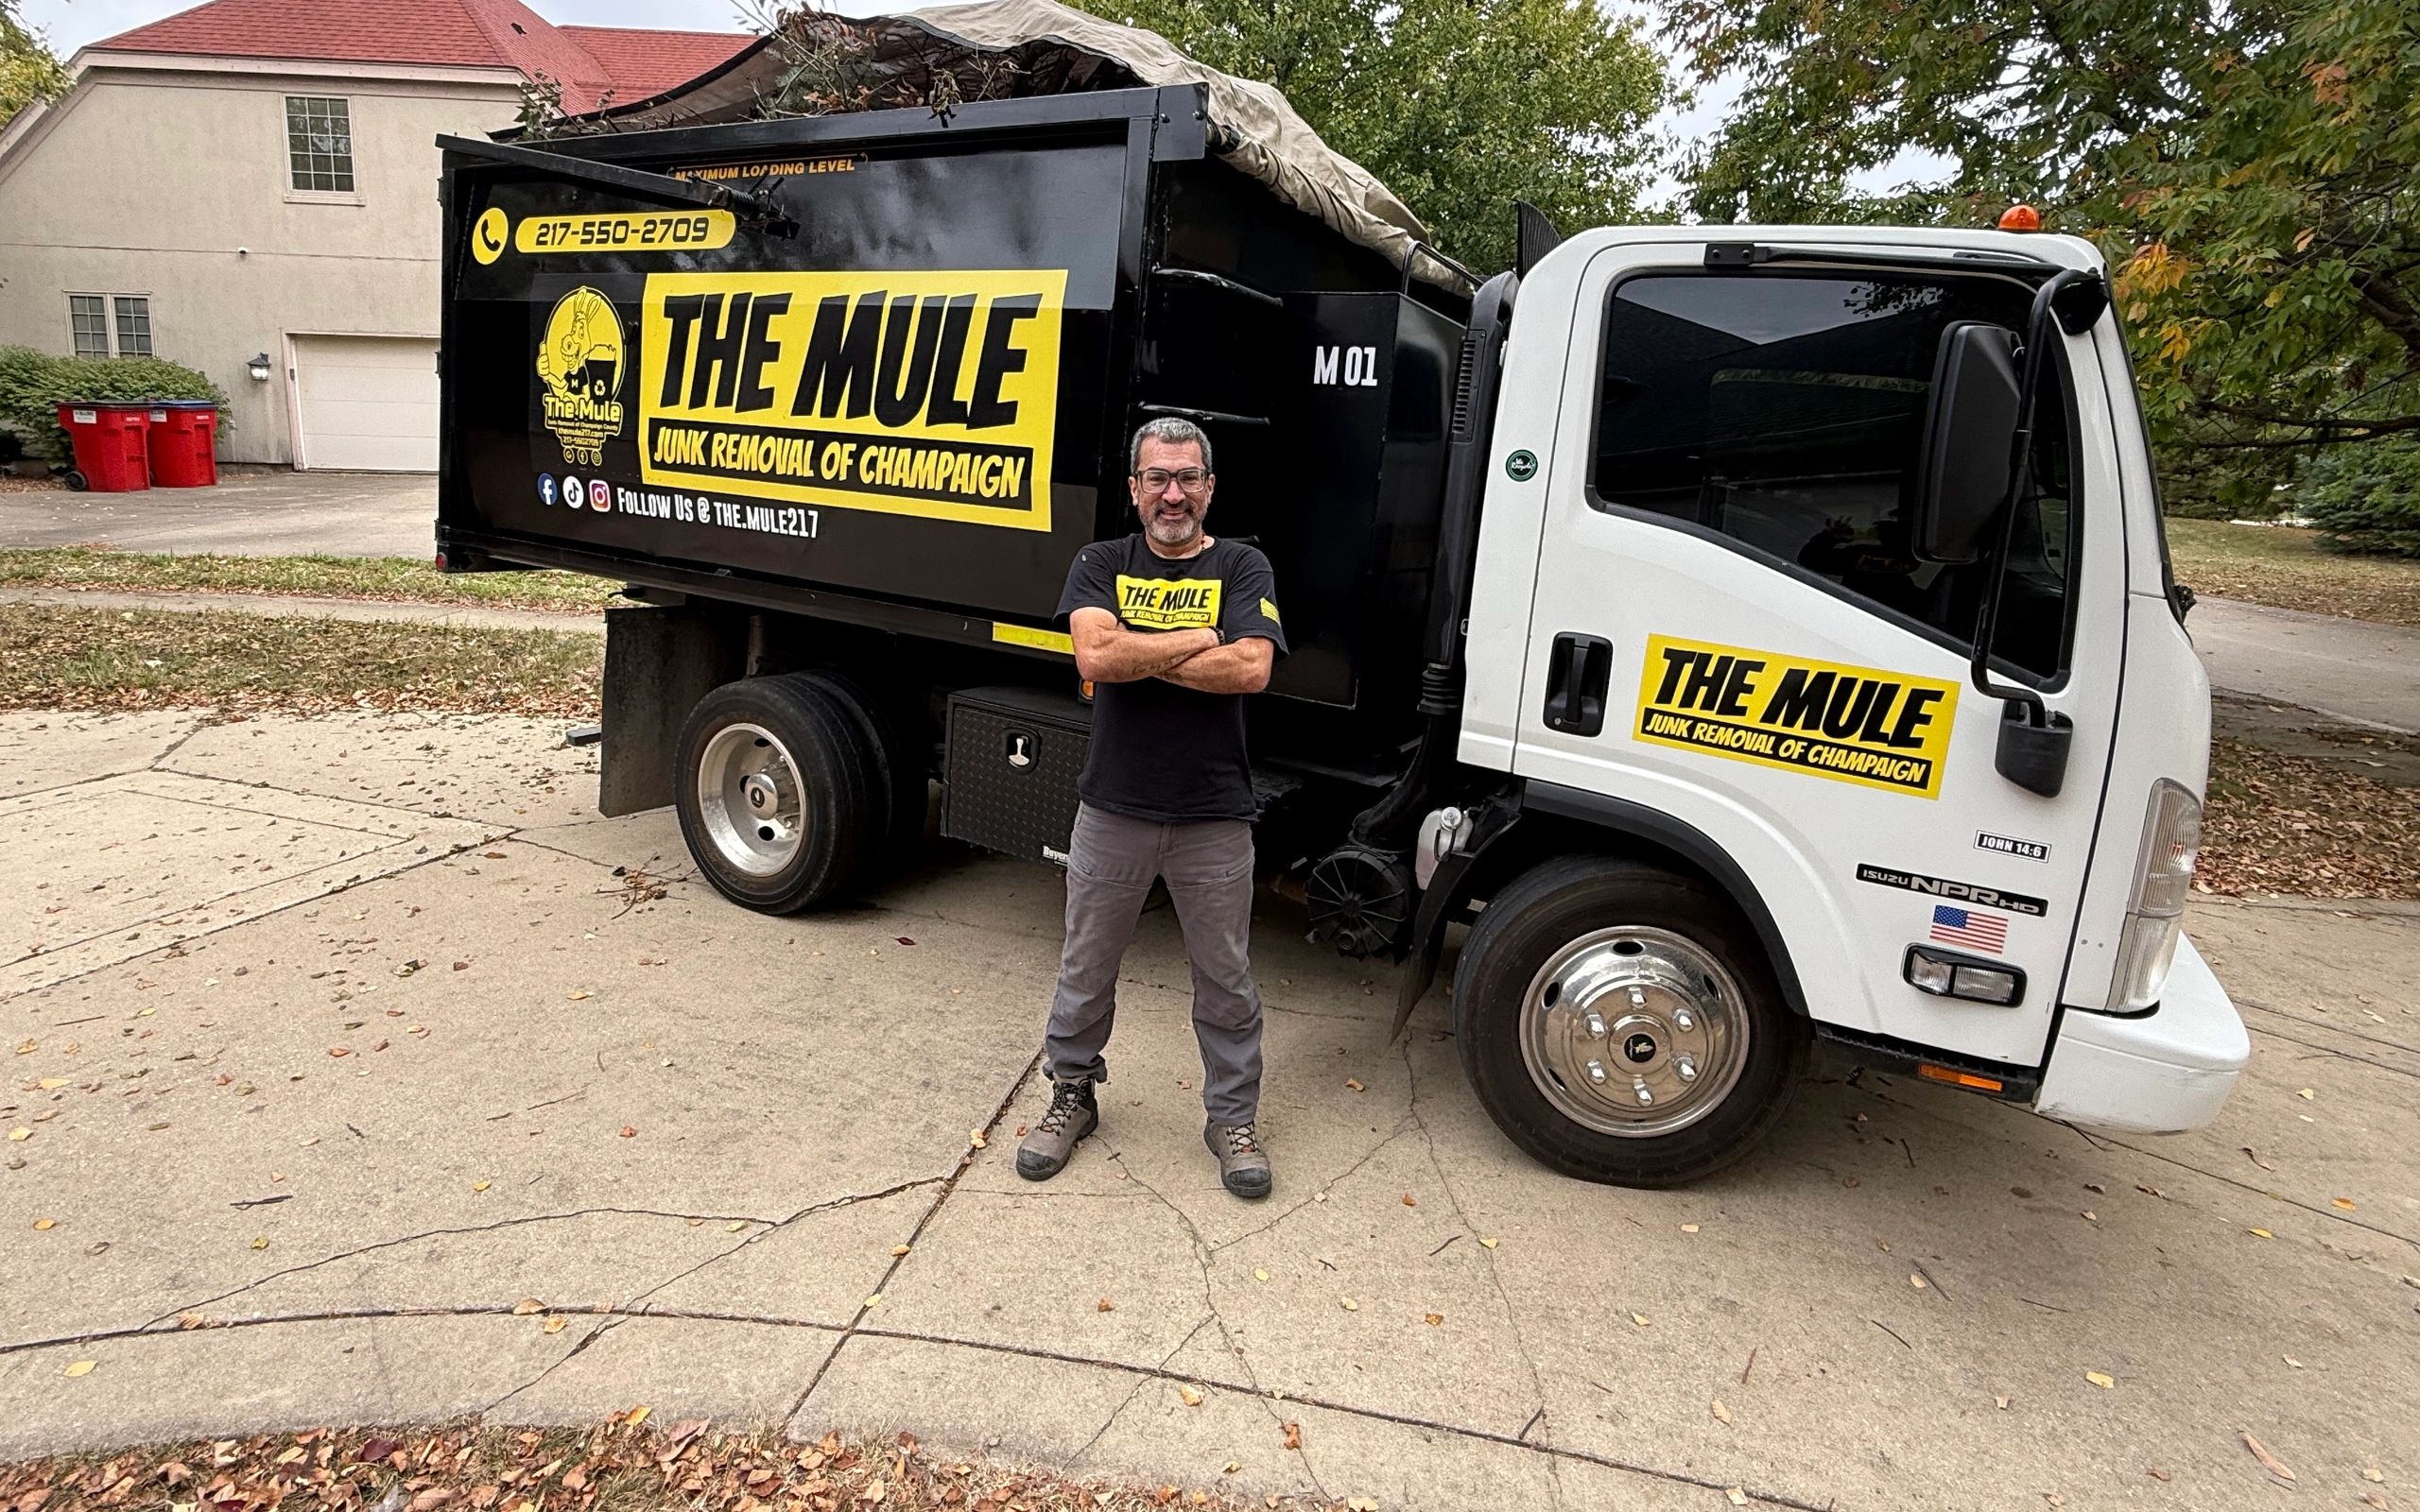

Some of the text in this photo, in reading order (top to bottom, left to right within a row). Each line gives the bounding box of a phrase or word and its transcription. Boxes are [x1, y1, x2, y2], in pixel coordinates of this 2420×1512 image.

[809, 159, 855, 174] LEVEL
[535, 217, 710, 246] 217-550-2709
[660, 290, 1044, 431] THE MULE
[1313, 346, 1377, 387] M 01
[545, 397, 620, 422] The Mule
[653, 426, 1026, 500] JUNK REMOVAL OF CHAMPAIGN
[713, 501, 819, 539] THE.MULE217
[1124, 585, 1212, 611] THE MULE
[1654, 647, 1945, 748] THE MULE
[1645, 713, 1927, 782] JUNK REMOVAL OF CHAMPAIGN
[1981, 835, 2042, 857] JOHN 14:6
[1862, 868, 1909, 885] ISUZU
[1910, 876, 1999, 906] NPR
